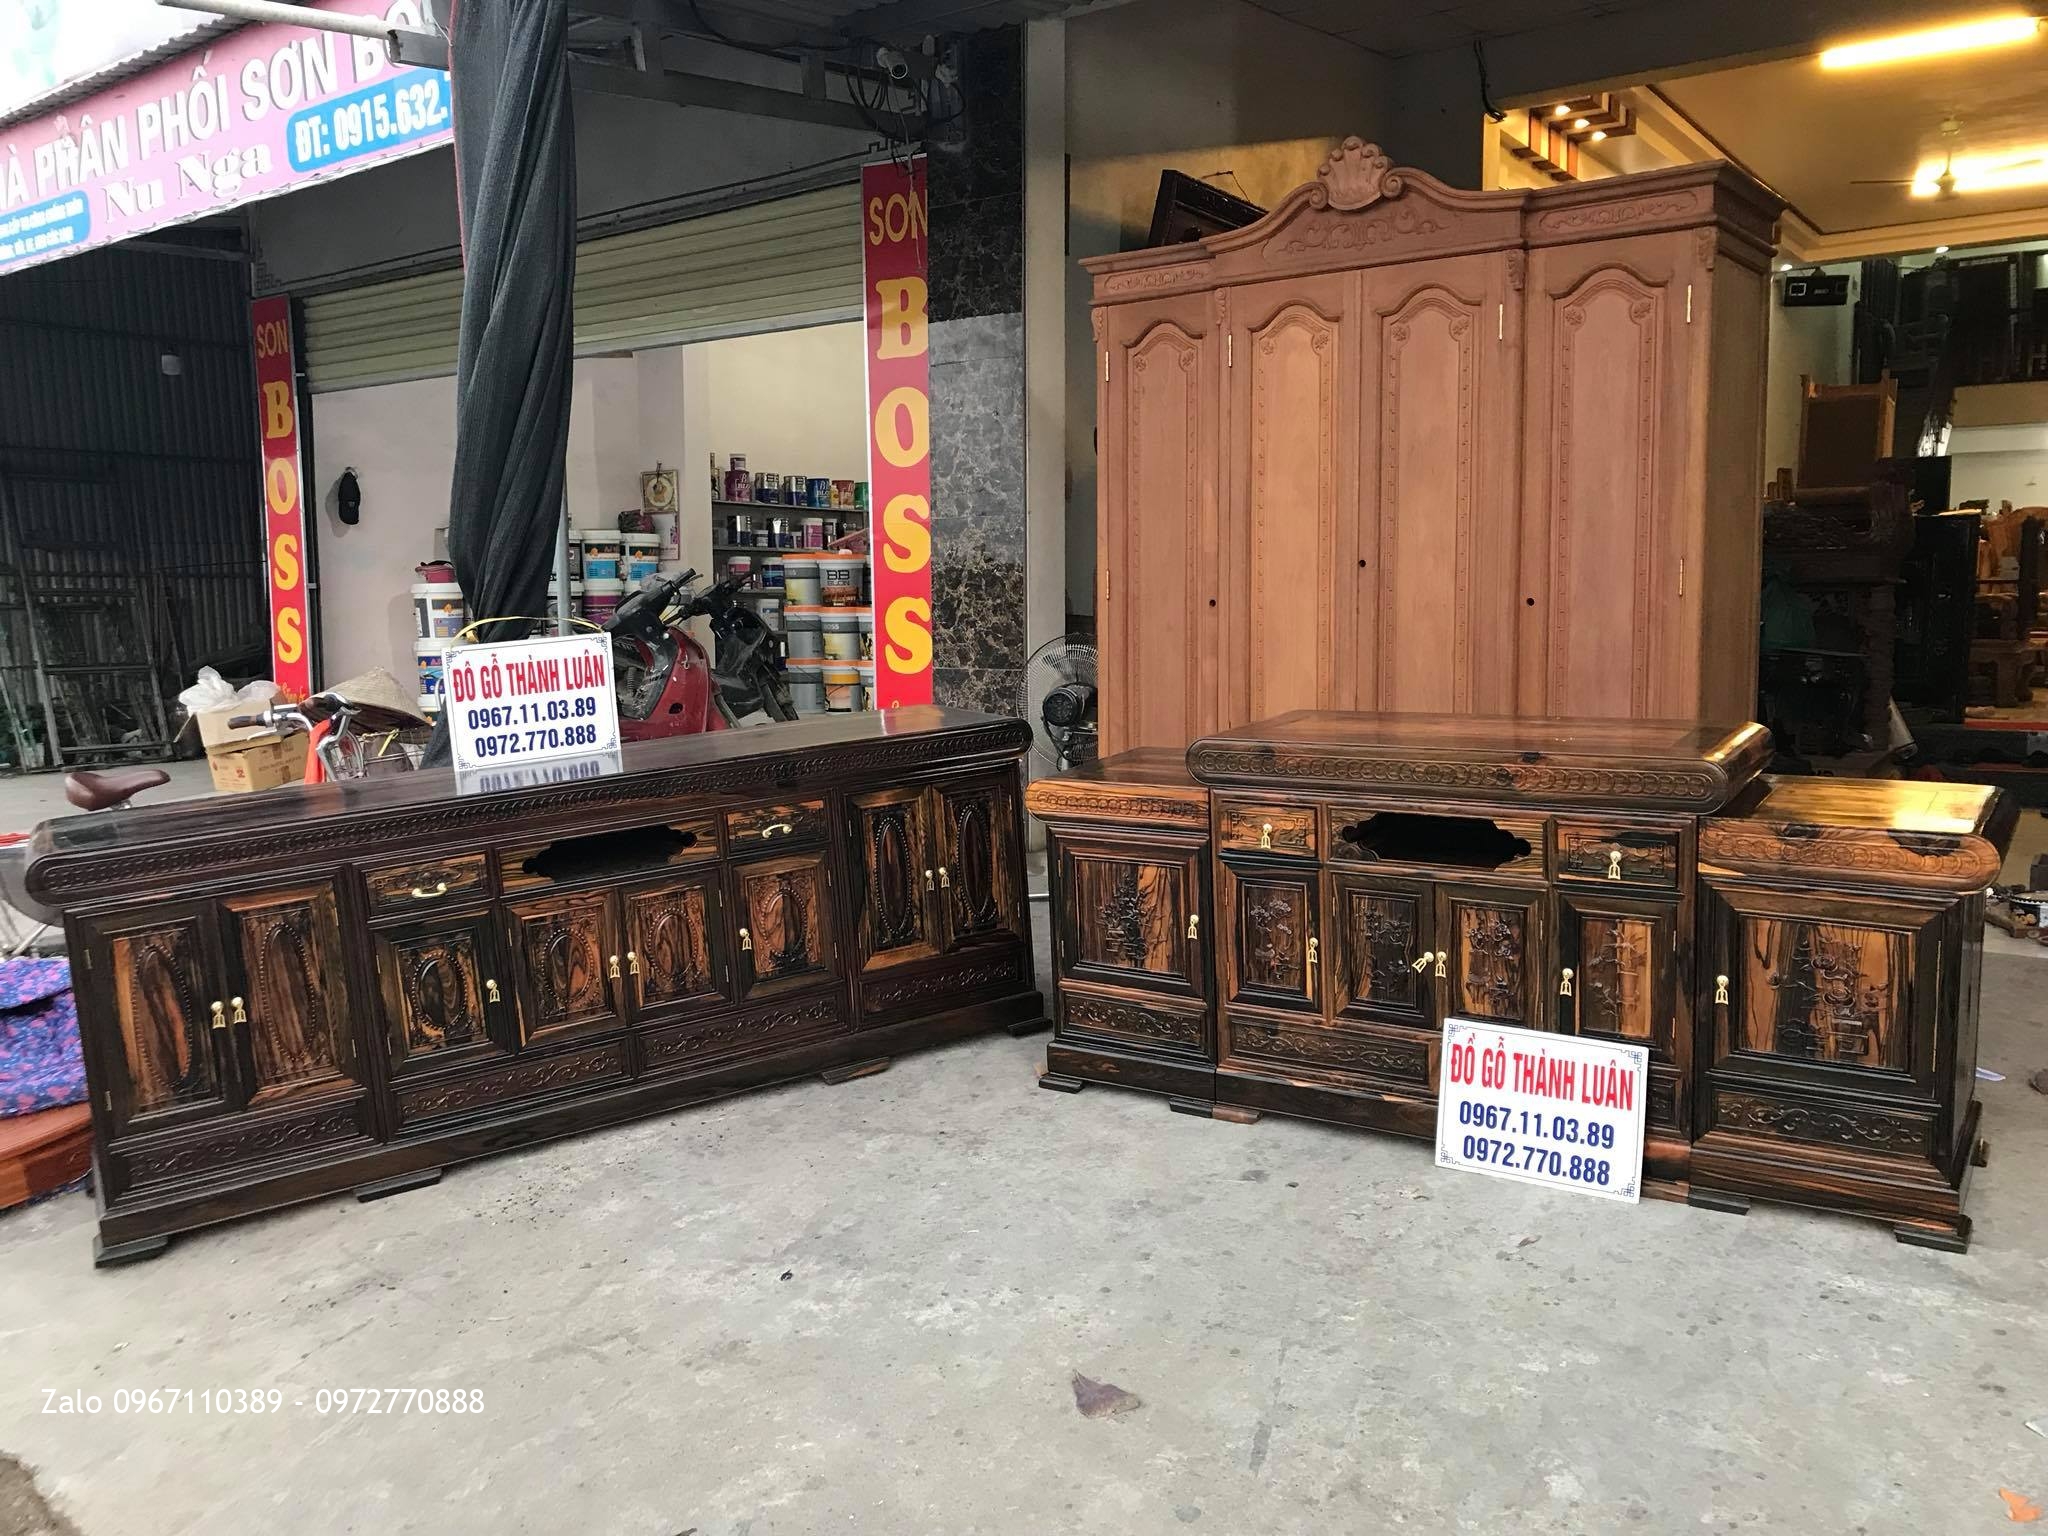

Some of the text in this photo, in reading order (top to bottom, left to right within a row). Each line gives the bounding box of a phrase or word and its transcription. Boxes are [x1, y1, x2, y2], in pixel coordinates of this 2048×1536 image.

[0, 143, 31, 210] À
[136, 49, 231, 160] PHỐI
[240, 31, 338, 121] SƠN
[174, 143, 274, 199] Nga
[874, 276, 933, 674] BOSS
[263, 380, 302, 664] BOSS
[480, 653, 502, 699] GỖ
[506, 654, 560, 697] THÀNH
[564, 649, 605, 690] LUÂN
[468, 697, 597, 730] 0967.11.03.89
[475, 724, 597, 758] 0972.770.888
[1451, 1033, 1634, 1111] ĐỒ GỖ THÀNH LUÂN
[1459, 1100, 1615, 1150] 0967.11.03.89
[1463, 1135, 1610, 1186] 0972.770.888
